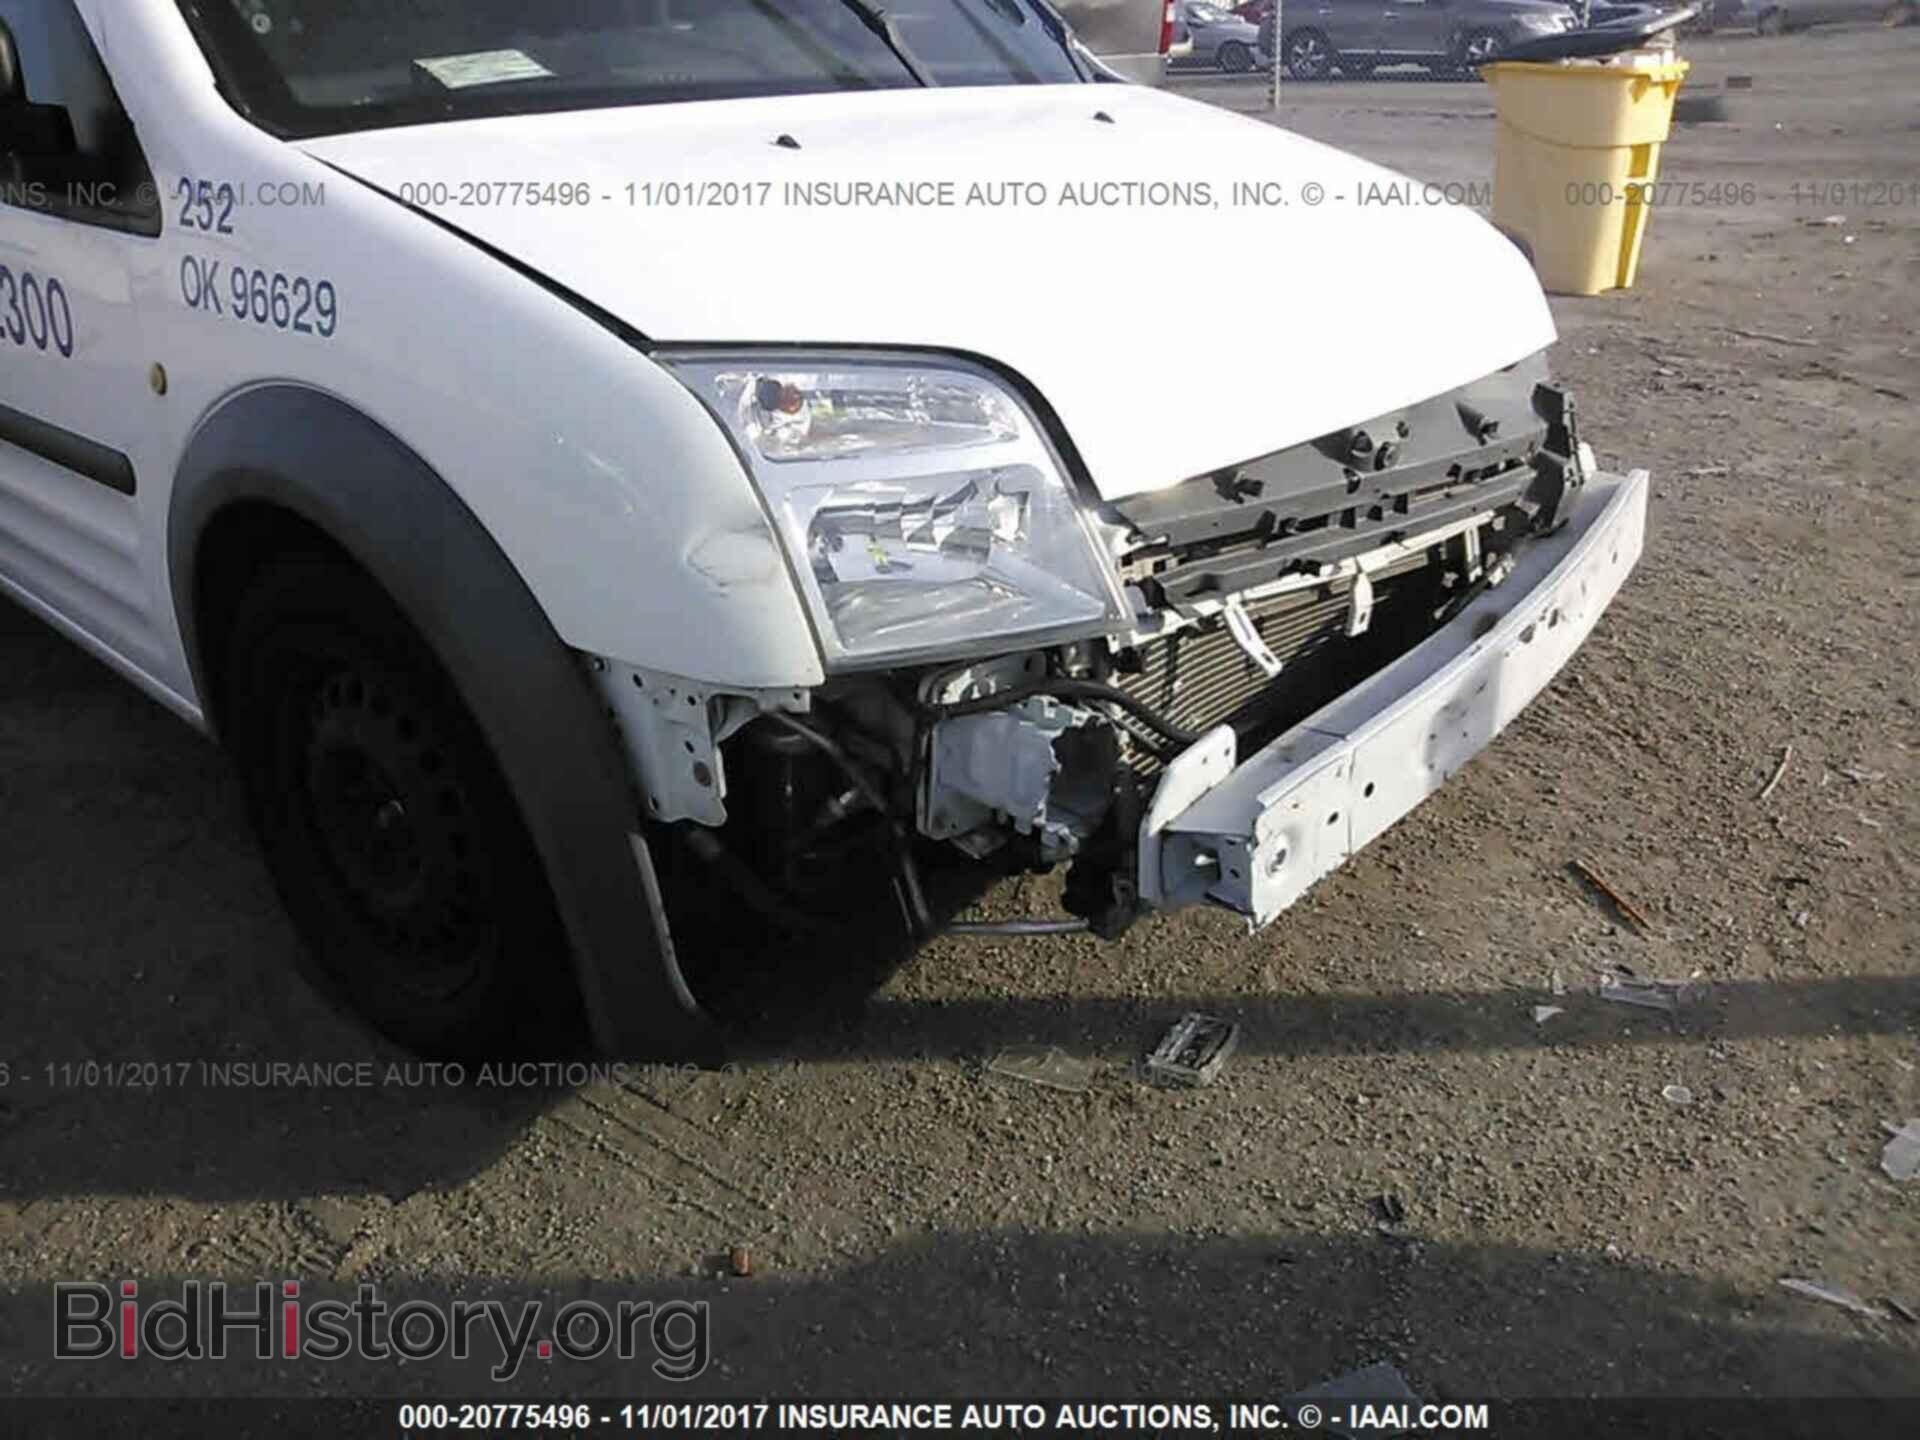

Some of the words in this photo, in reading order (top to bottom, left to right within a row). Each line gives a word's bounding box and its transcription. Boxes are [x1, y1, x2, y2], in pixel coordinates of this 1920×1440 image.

[178, 176, 232, 233] 252
[0, 263, 73, 358] 300
[180, 255, 222, 314] OK
[231, 266, 336, 337] 96629
